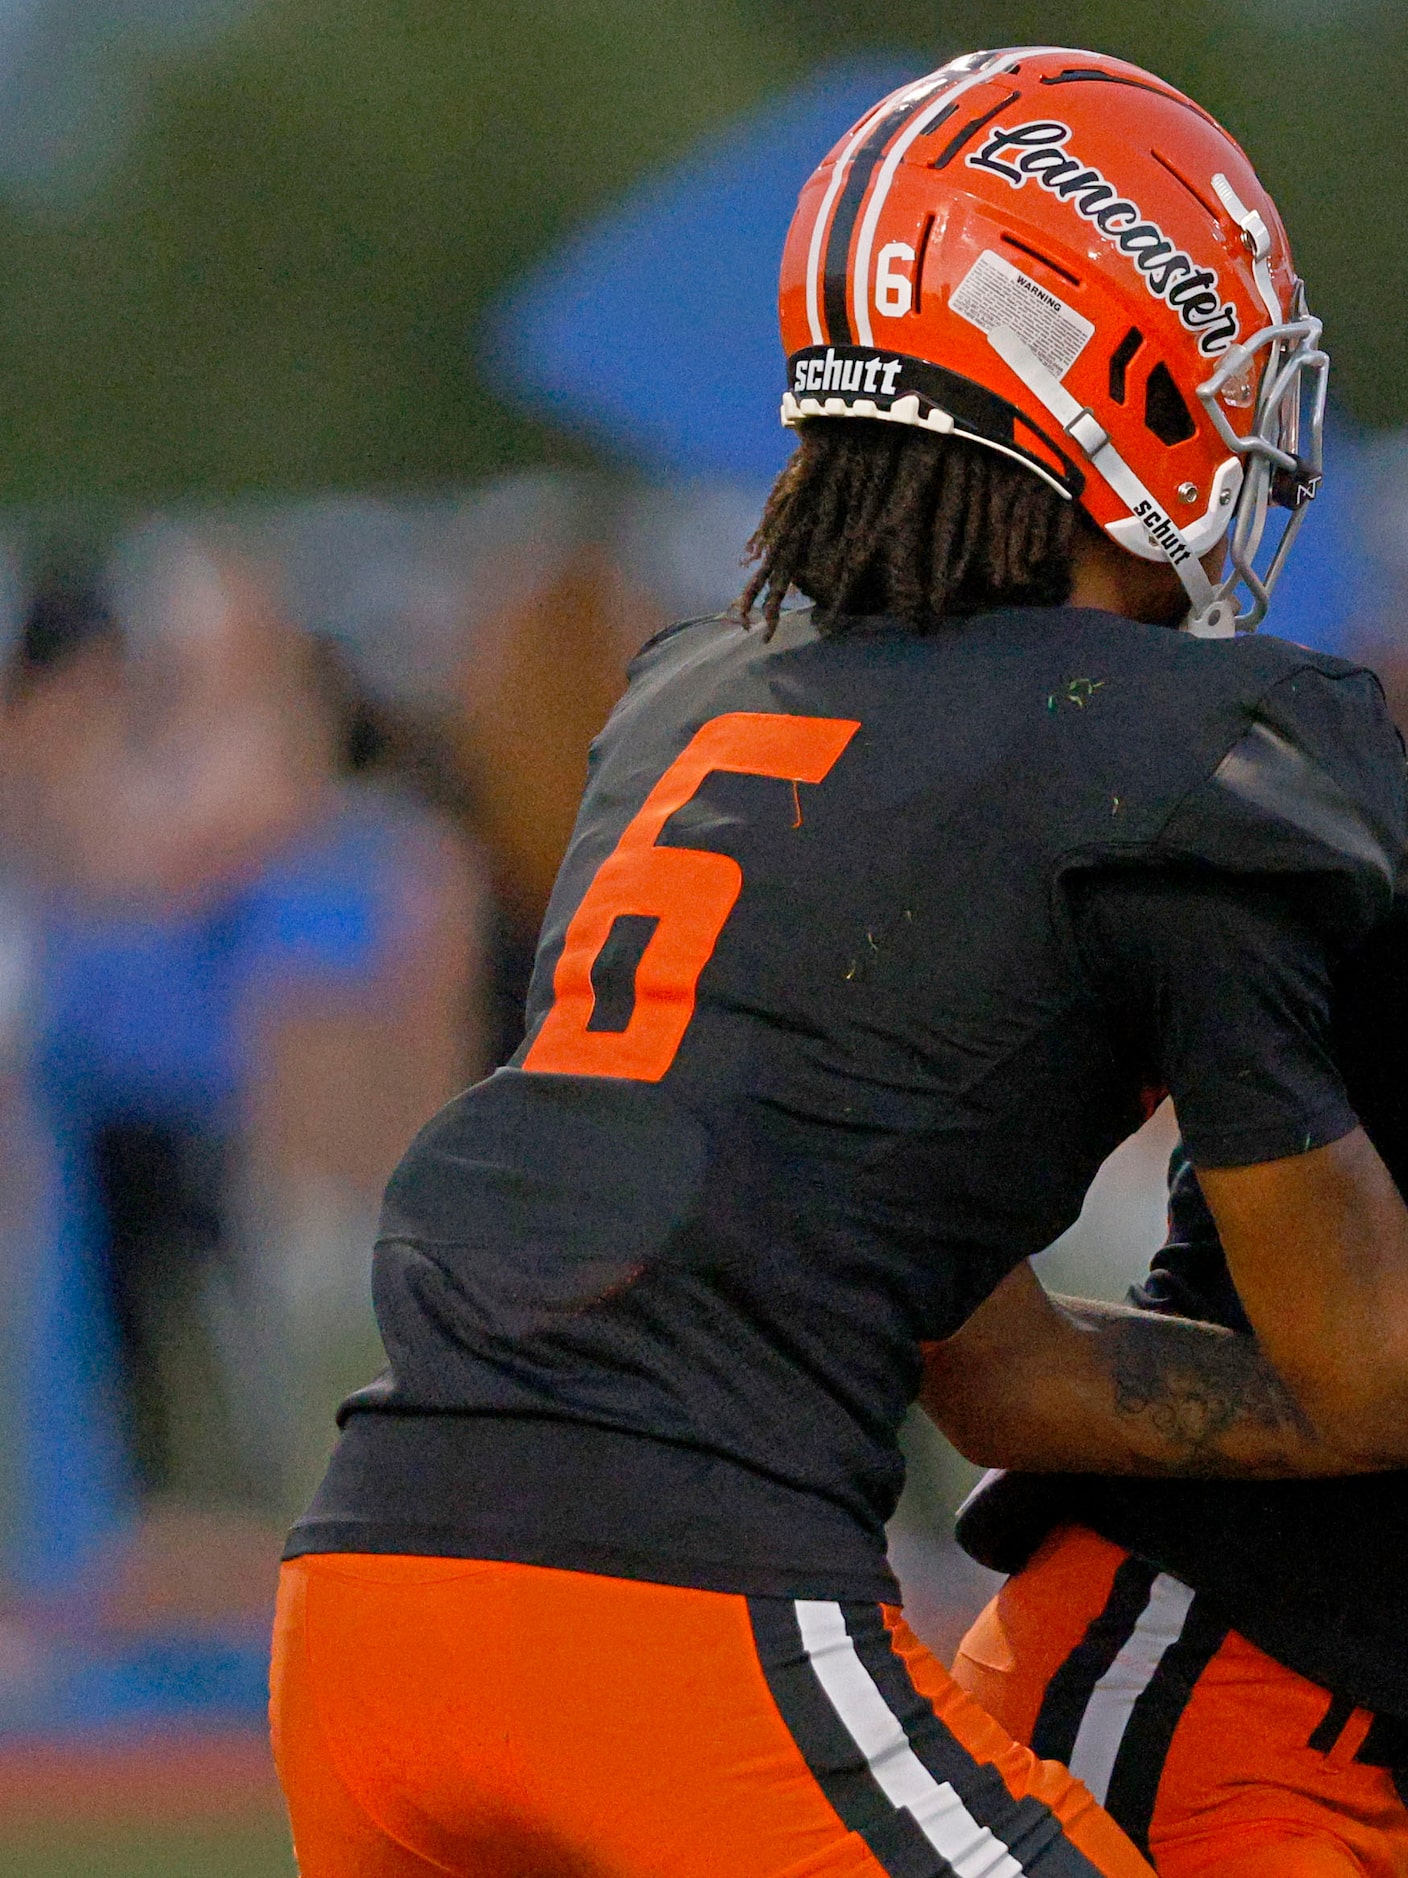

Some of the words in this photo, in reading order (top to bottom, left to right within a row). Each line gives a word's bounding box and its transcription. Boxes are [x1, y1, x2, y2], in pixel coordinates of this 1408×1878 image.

[967, 122, 1241, 356] Lancaster
[875, 242, 915, 318] 6
[1017, 275, 1062, 311] WARNING
[794, 348, 902, 395] schutt
[1133, 500, 1191, 565] schutt
[522, 711, 862, 1082] 6
